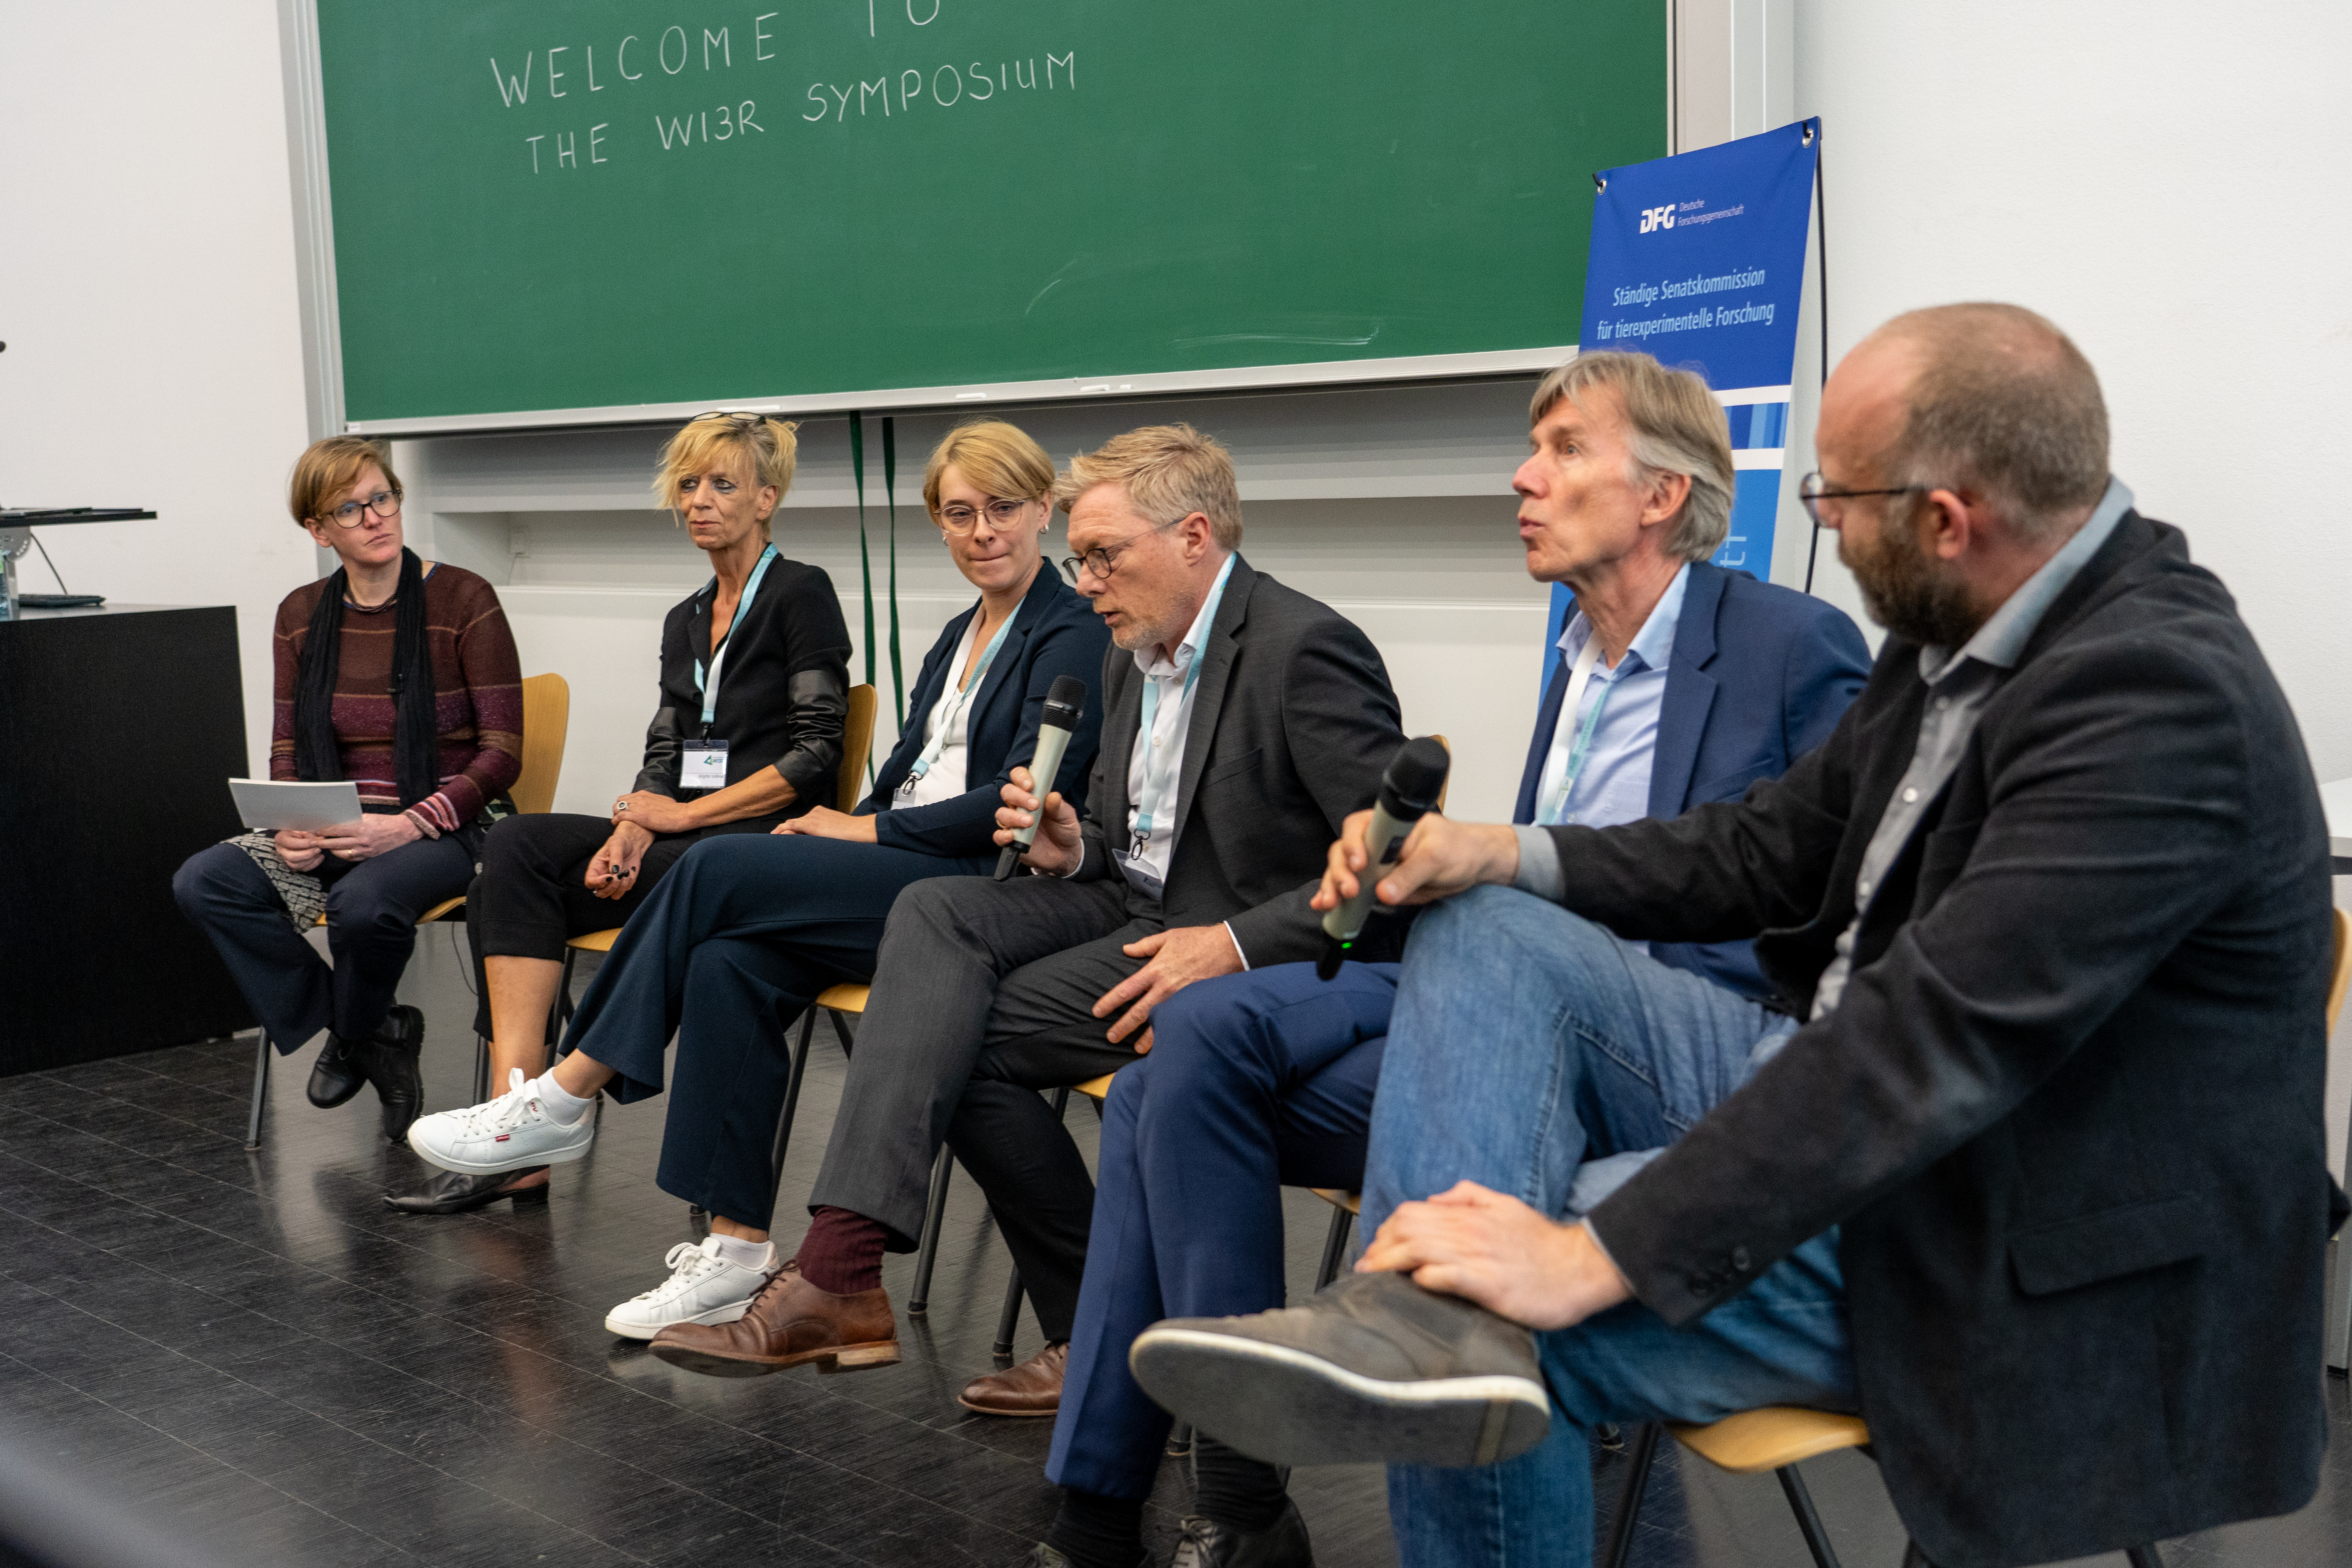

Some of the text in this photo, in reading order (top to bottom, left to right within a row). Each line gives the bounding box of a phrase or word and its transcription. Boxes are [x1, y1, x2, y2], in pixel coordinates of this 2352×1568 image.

[490, 12, 778, 108] WELCOME
[526, 51, 1074, 173] THE WI3R SYMPOSIUM
[1640, 204, 1675, 233] DFG
[1679, 199, 1705, 212] Deutsche
[1613, 266, 1765, 307] Ständige Senatskommission
[1598, 301, 1774, 340] für tierexperimentelle Forschung
